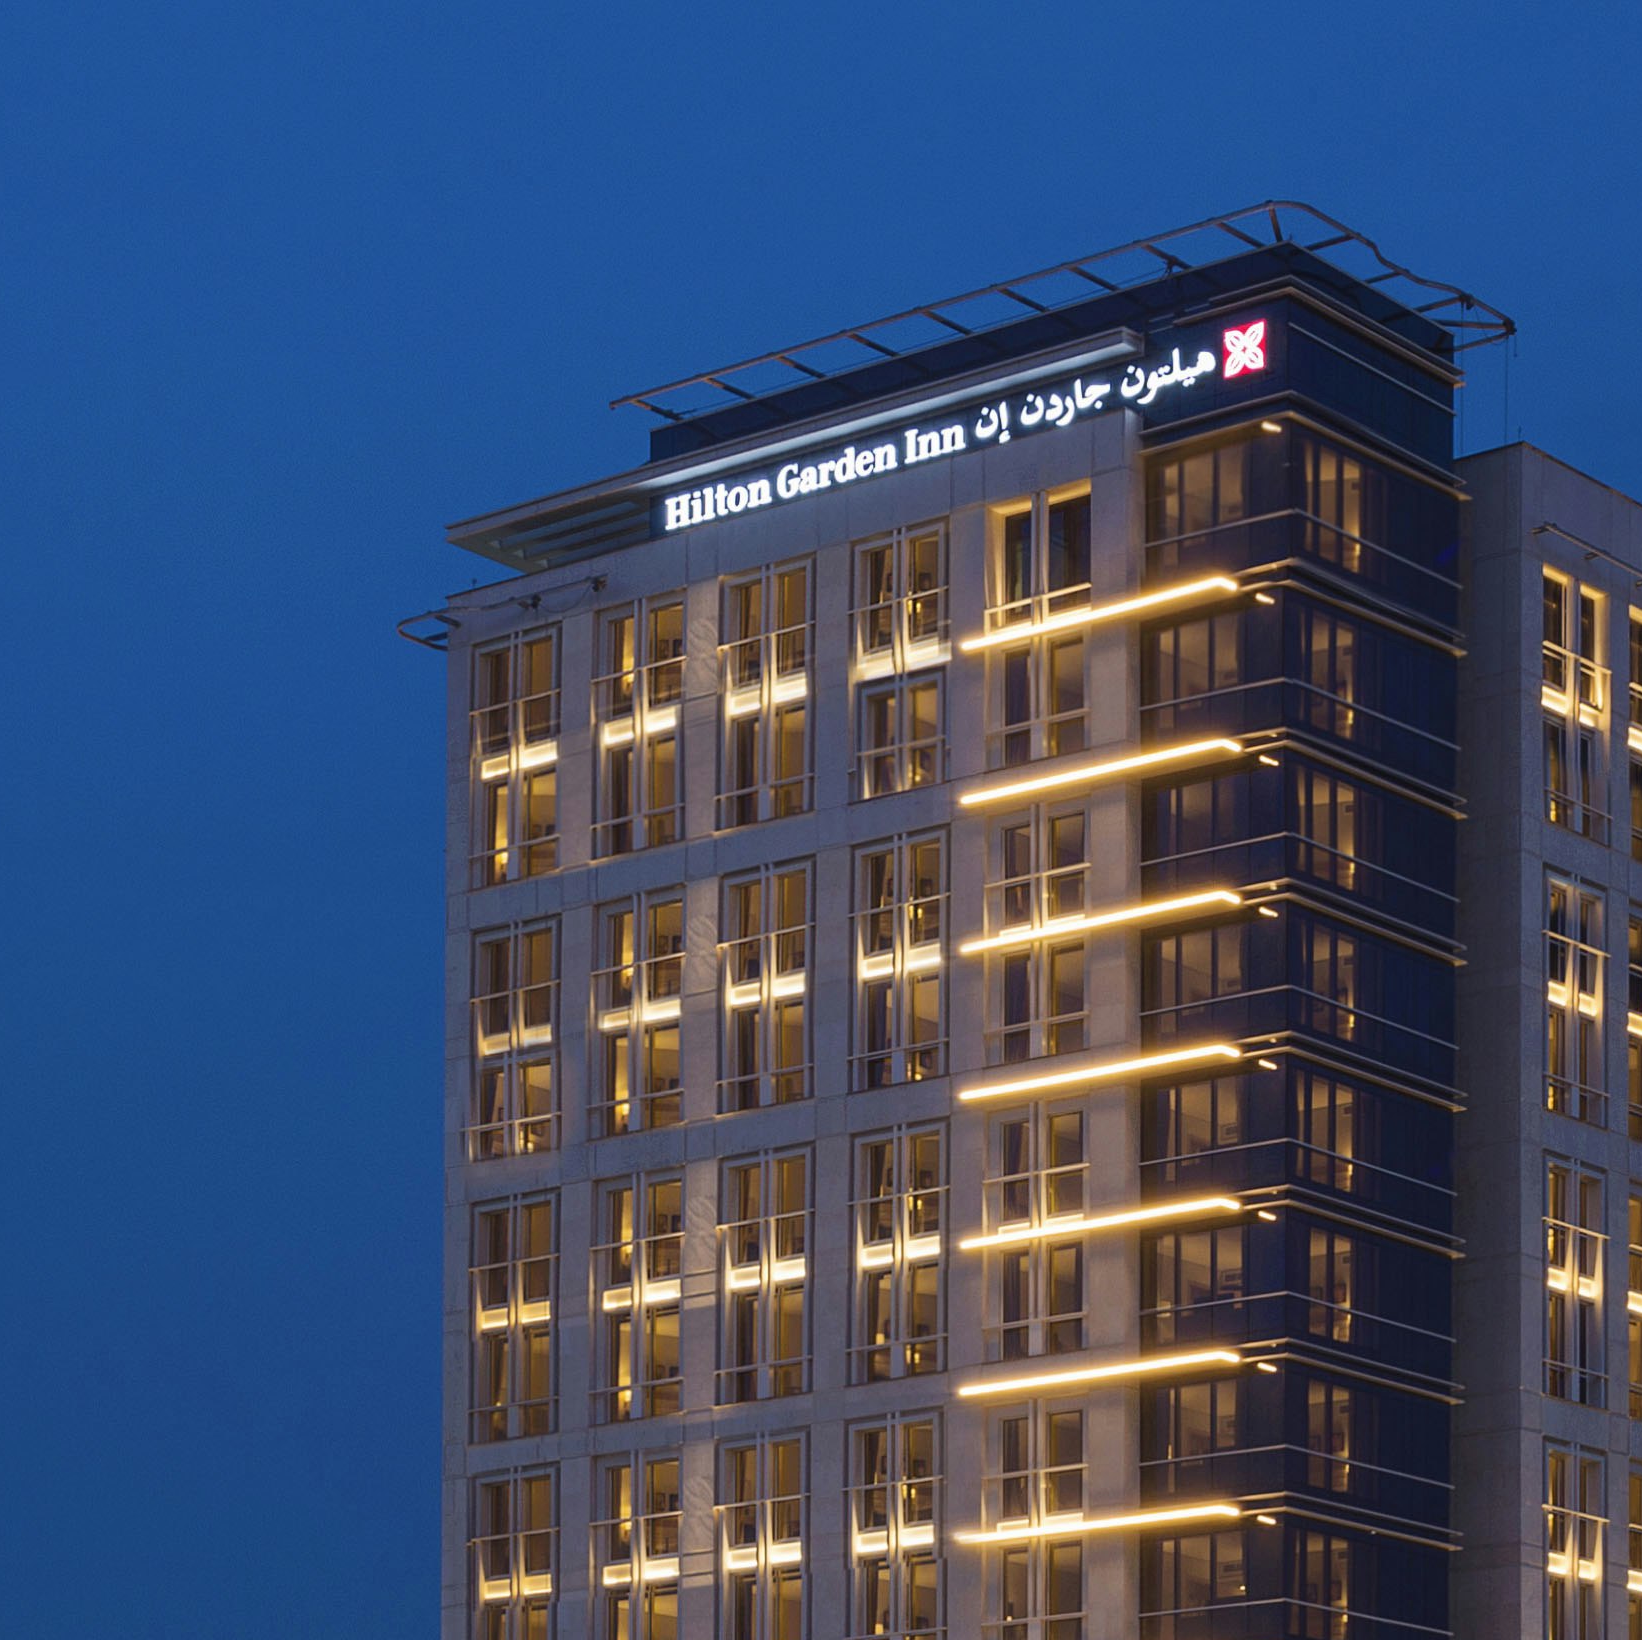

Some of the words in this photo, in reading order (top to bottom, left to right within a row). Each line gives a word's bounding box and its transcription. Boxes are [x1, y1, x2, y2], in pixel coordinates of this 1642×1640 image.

[1020, 378, 1111, 426] جاردن
[1121, 349, 1216, 405] هيلتون
[975, 401, 1011, 443] إن
[664, 479, 772, 531] Hilton
[776, 444, 898, 499] Garden
[904, 424, 966, 465] Inn
